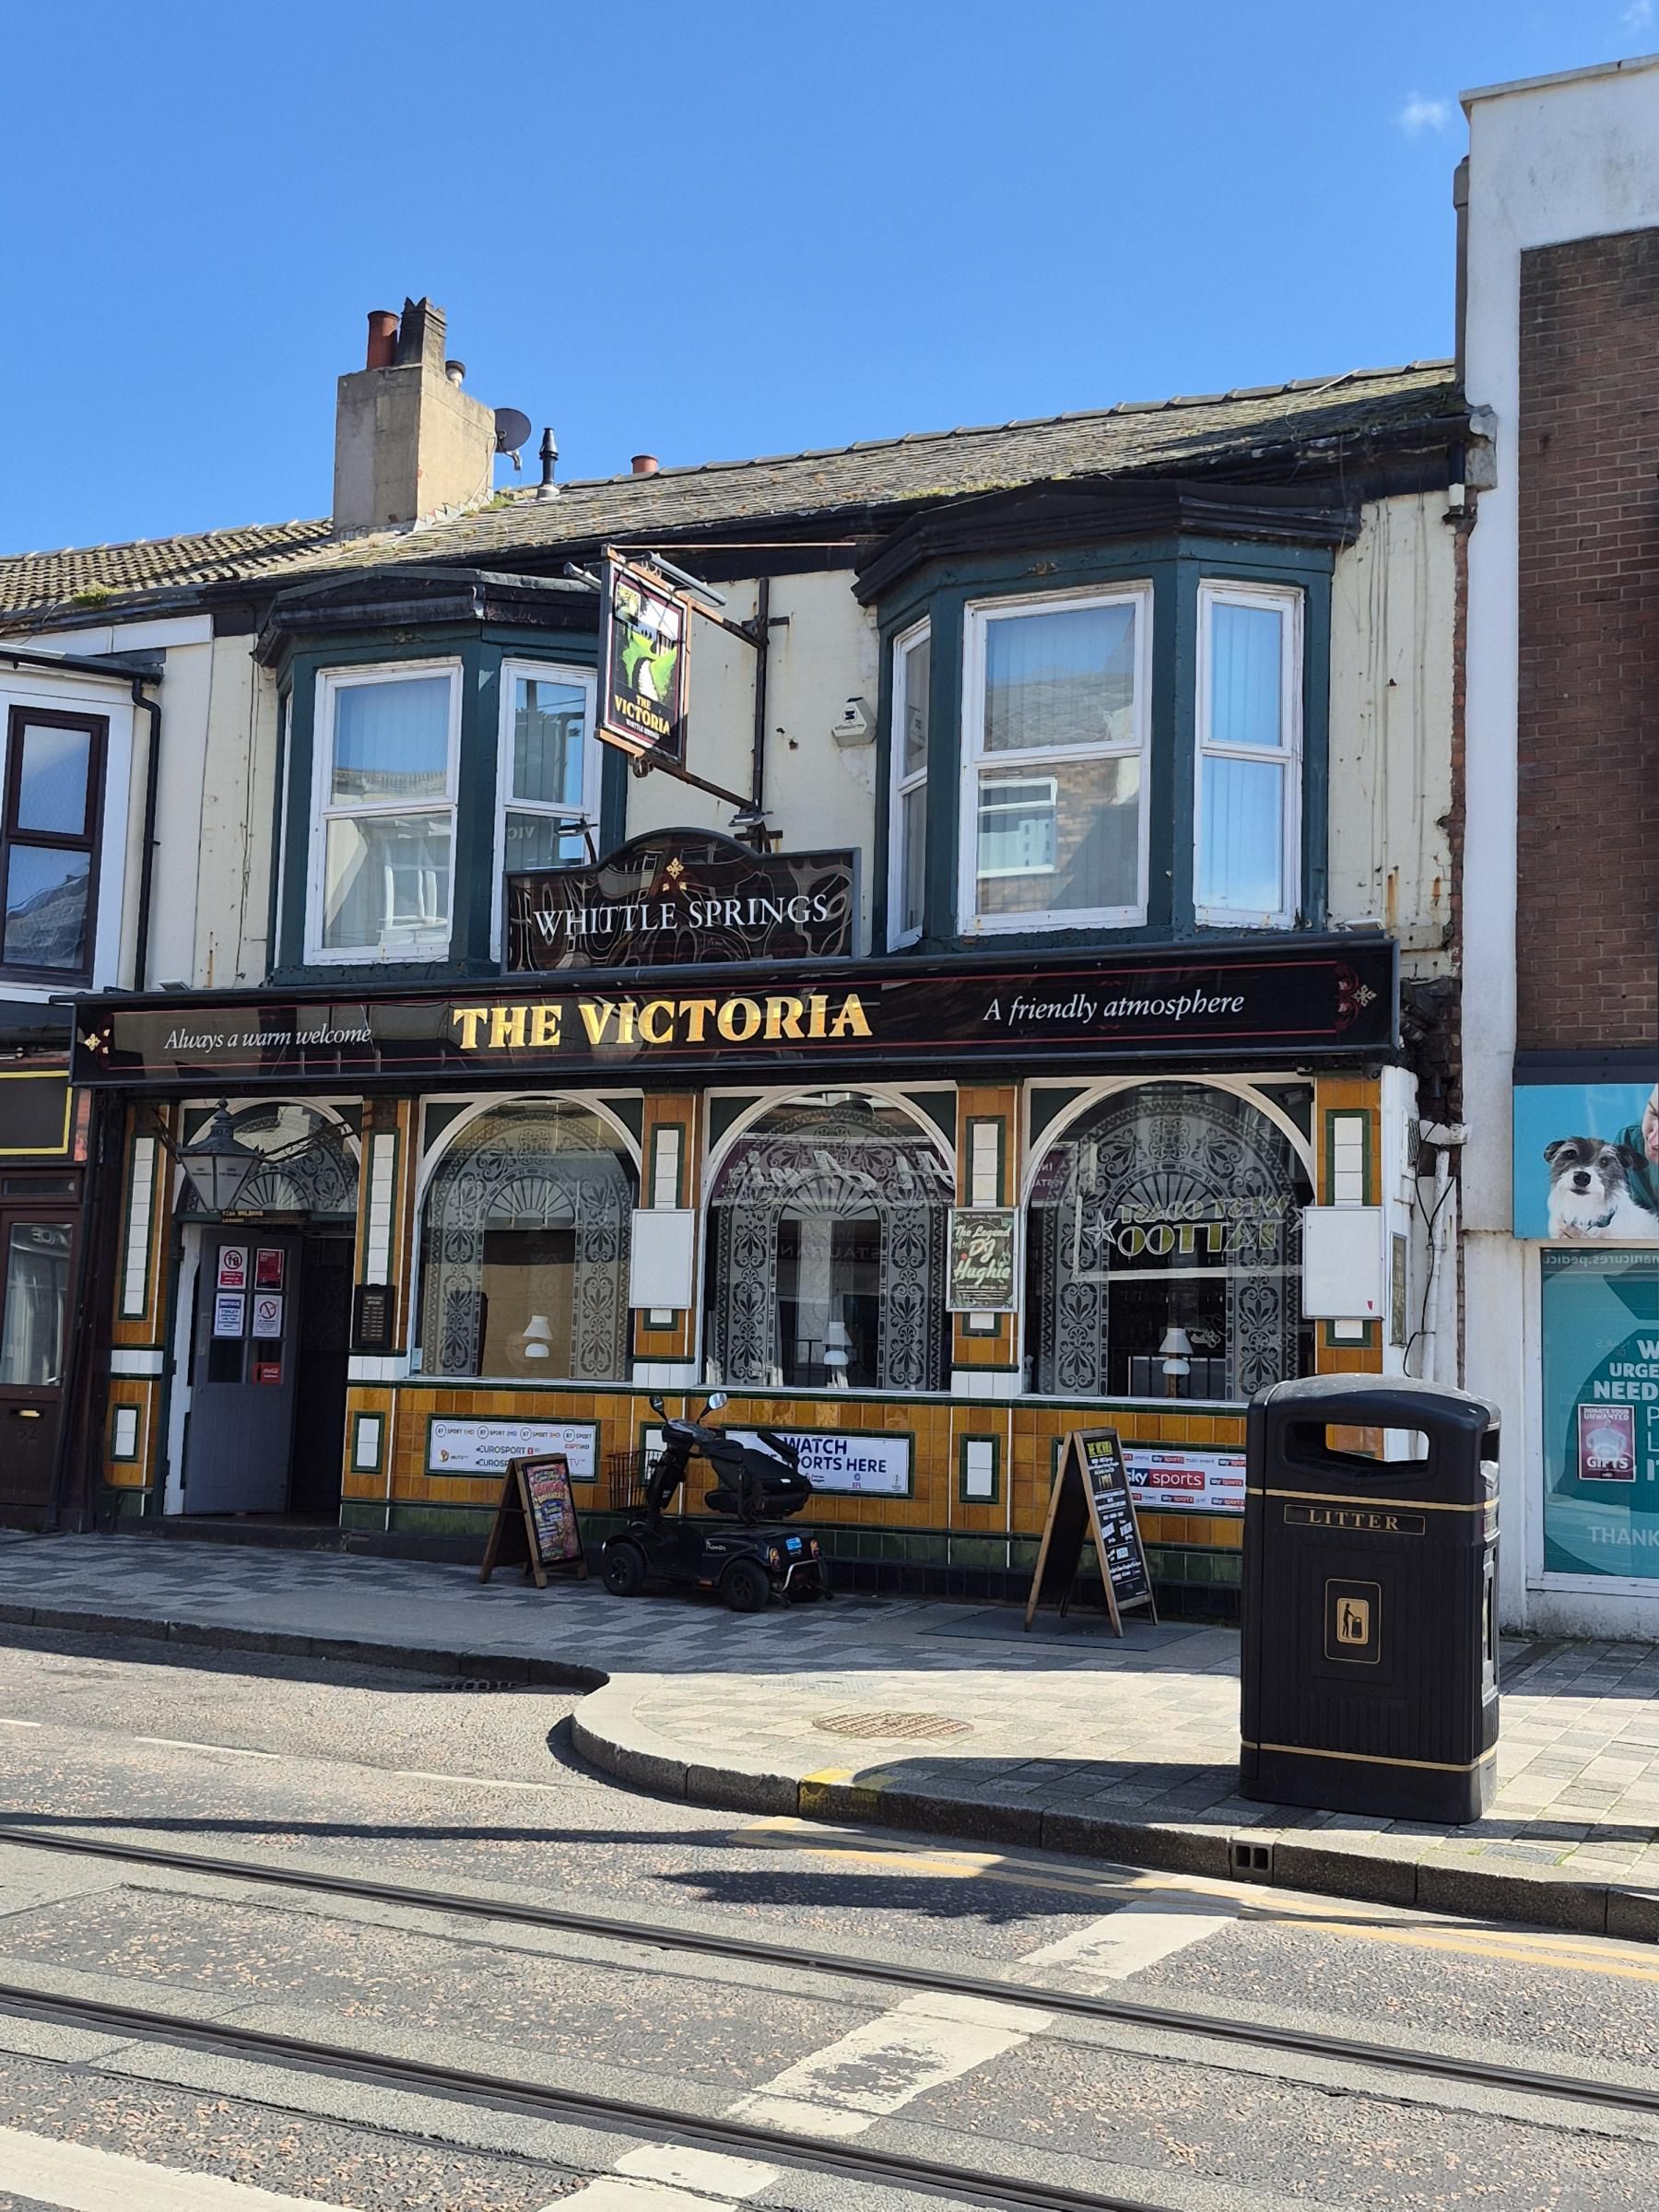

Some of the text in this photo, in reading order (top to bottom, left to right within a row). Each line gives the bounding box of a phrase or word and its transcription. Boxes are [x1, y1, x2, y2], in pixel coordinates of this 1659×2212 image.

[636, 695, 651, 710] THE
[615, 694, 671, 736] VICTORIA
[533, 894, 828, 938] WHITTLE SPRINGS
[982, 989, 1244, 1026] A friendly atmosphere
[453, 993, 874, 1049] THE VICTORIA
[163, 1023, 372, 1053] Always a warm welcome
[955, 1225, 1012, 1241] The Legend
[969, 1238, 995, 1264] DJ
[953, 1259, 1011, 1285] Hughie
[1584, 1413, 1630, 1421] UNWANTED
[477, 1444, 525, 1455] EUROSPORT
[783, 1436, 848, 1456] WATCH
[477, 1459, 511, 1468] EUROSP
[799, 1455, 887, 1474] ORTS HERE
[1586, 1456, 1629, 1470] GIFTS
[1152, 1472, 1203, 1487] sports
[1173, 1496, 1194, 1504] sports
[1309, 1509, 1400, 1531] LITTER
